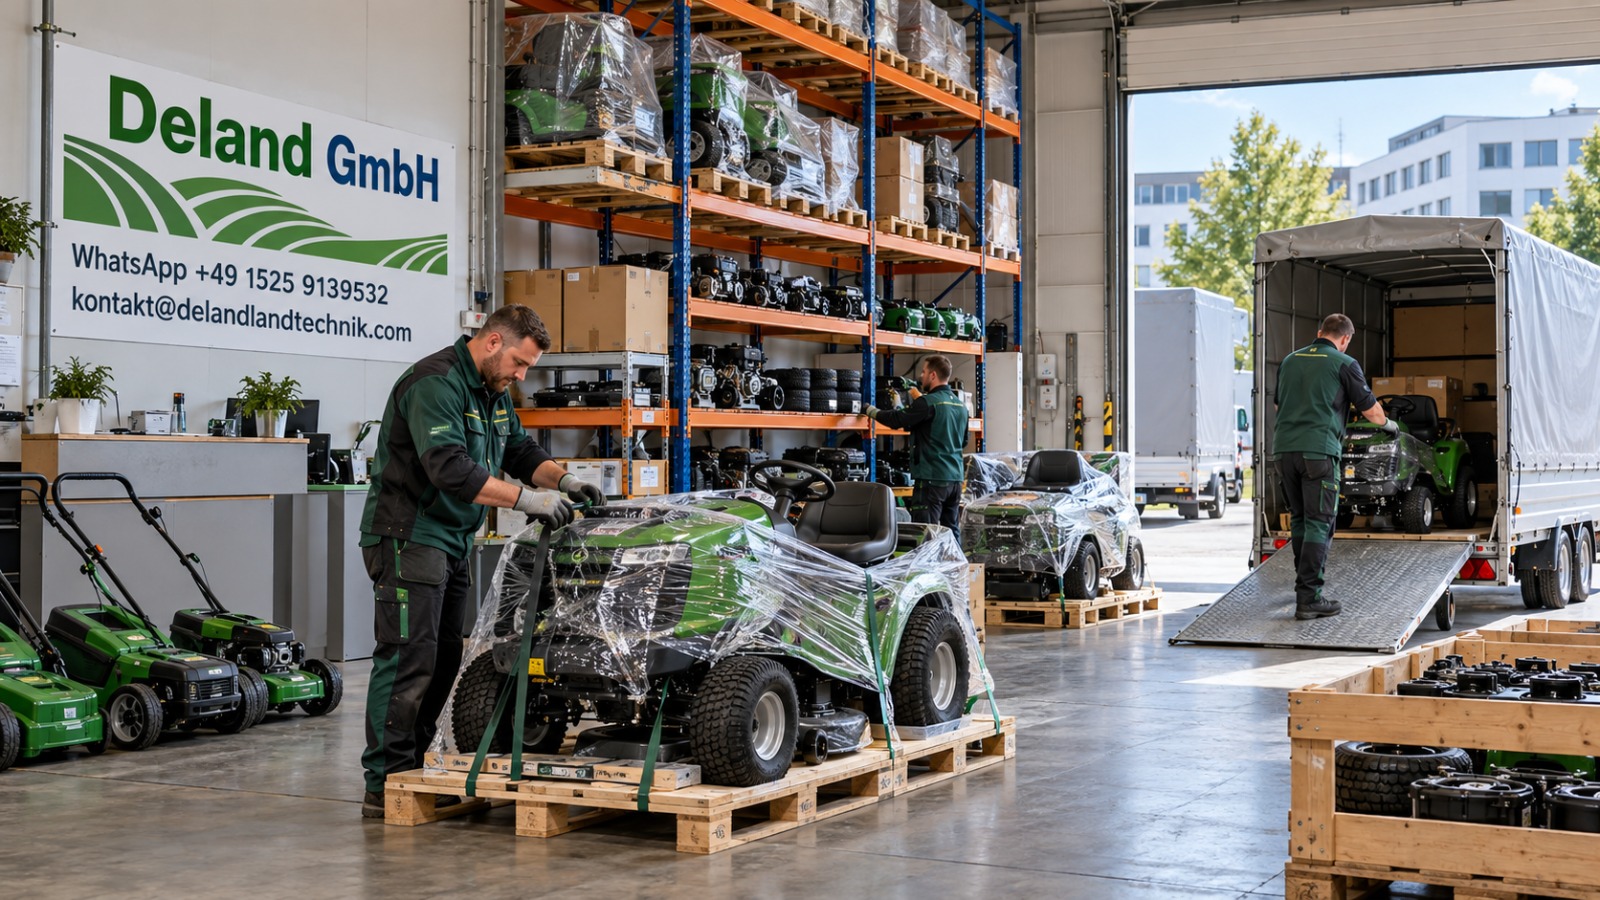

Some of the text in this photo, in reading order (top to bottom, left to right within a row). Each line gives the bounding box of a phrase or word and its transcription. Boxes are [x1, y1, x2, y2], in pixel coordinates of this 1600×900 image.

[109, 75, 439, 202] Deland GmbH
[72, 243, 389, 305] WhatsApp +49 1525 9139532
[72, 286, 412, 342] kontakt@delandlandtechnik.com
